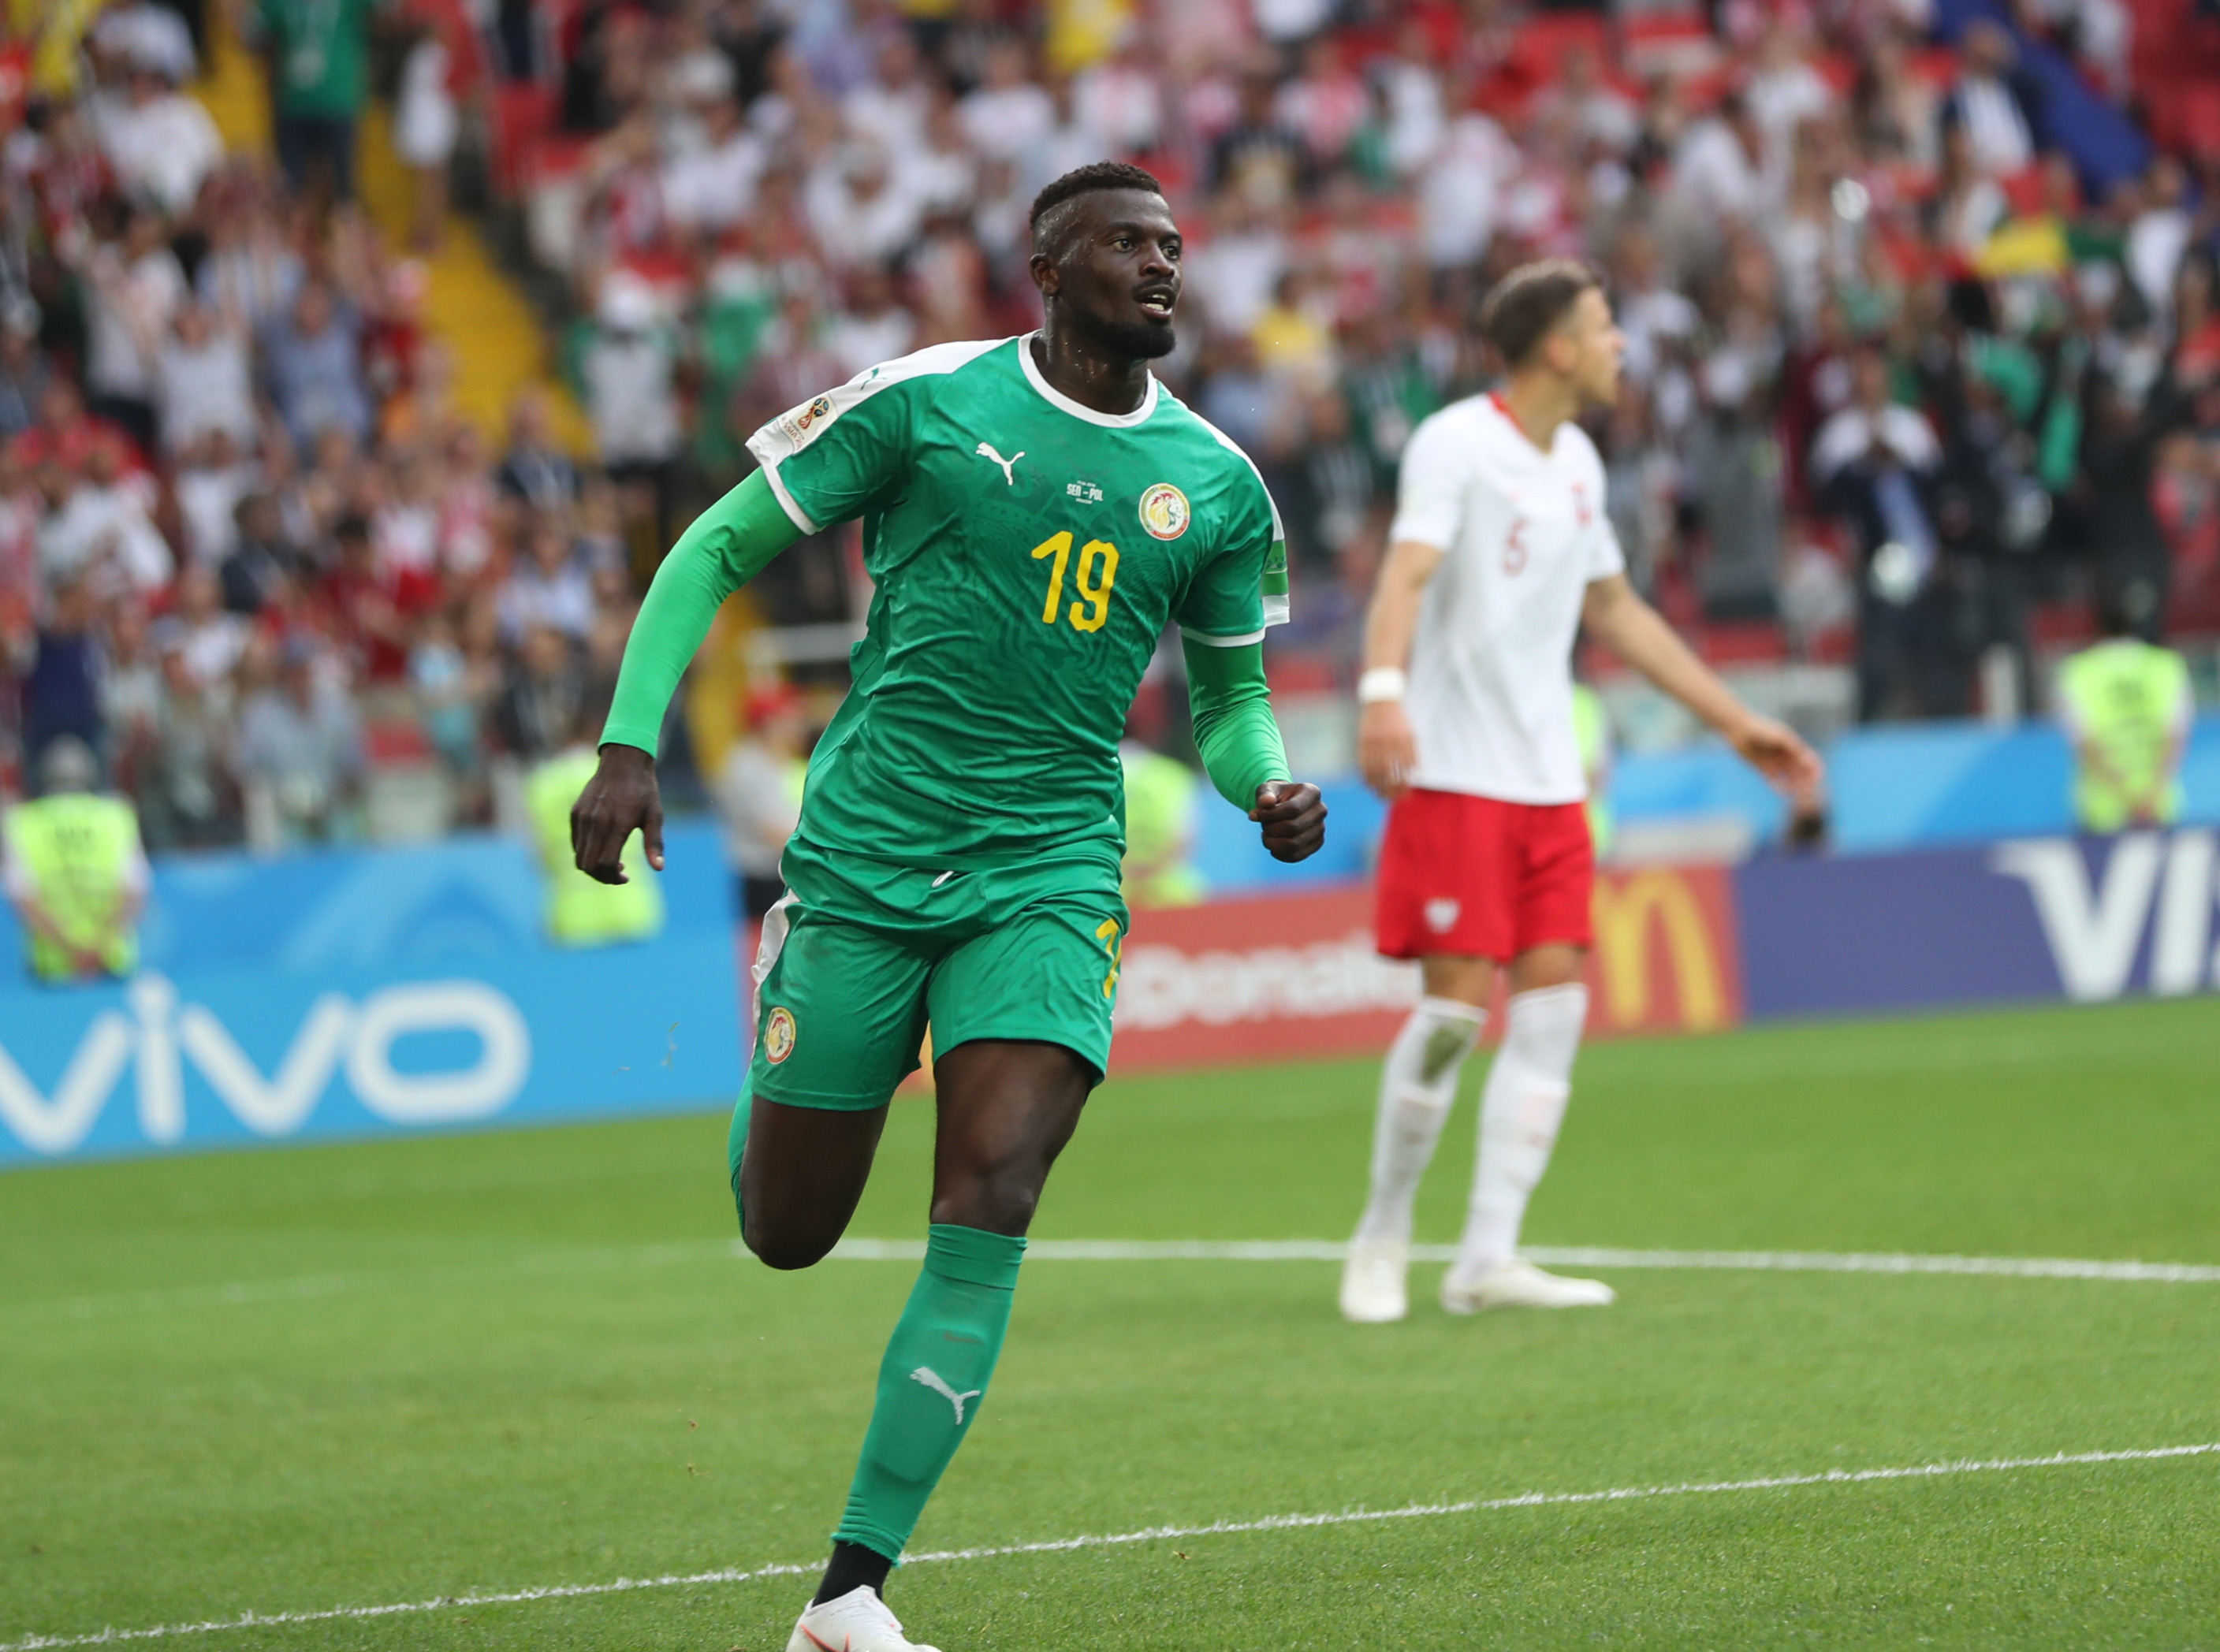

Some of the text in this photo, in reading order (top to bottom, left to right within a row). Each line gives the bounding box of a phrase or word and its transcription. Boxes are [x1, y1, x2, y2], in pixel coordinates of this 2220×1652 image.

[1066, 483, 1082, 497] SEN
[1089, 488, 1103, 501] POL
[1030, 530, 1120, 633] 19
[1502, 517, 1532, 578] 5
[1987, 832, 2220, 1003] VI
[0, 974, 531, 1153] vivo
